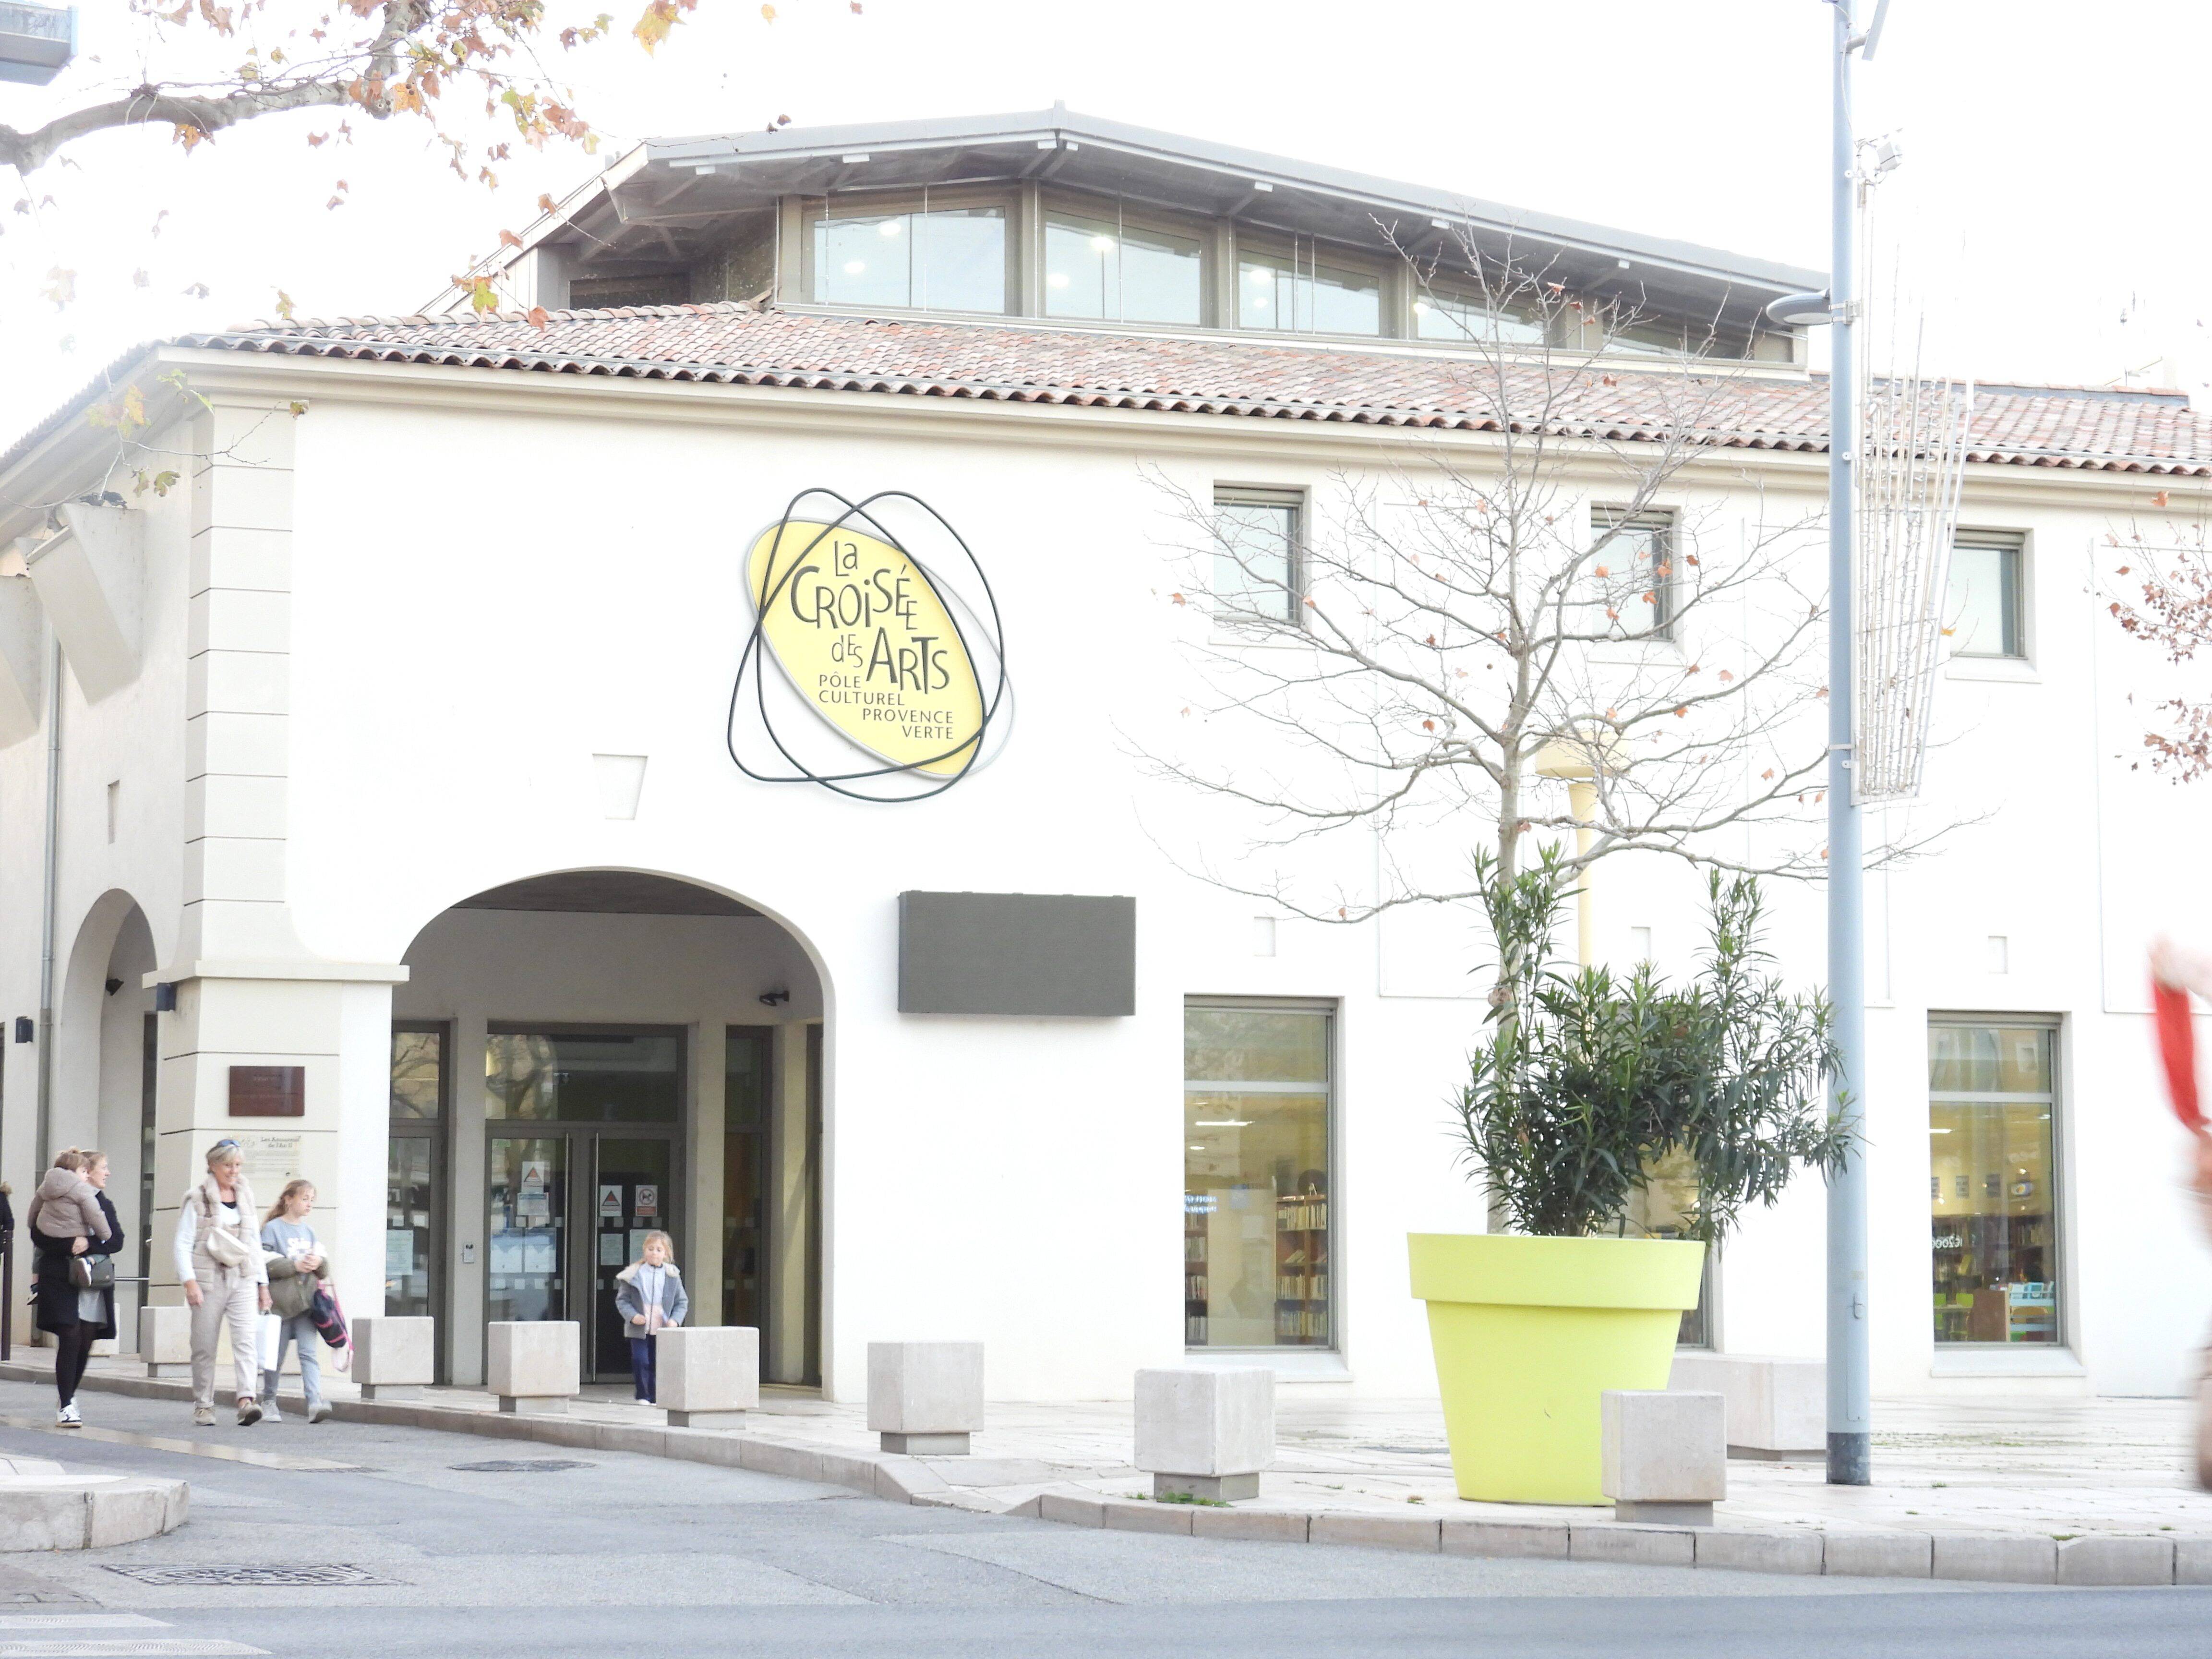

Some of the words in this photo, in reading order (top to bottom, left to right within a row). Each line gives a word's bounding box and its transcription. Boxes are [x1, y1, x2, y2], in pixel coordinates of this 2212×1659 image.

[834, 540, 858, 577] La
[866, 626, 950, 695] ARTS
[819, 671, 861, 688] PÔLE
[819, 689, 905, 706] CULTUREL
[863, 708, 953, 724] PROVENCE
[902, 725, 953, 739] VERTE
